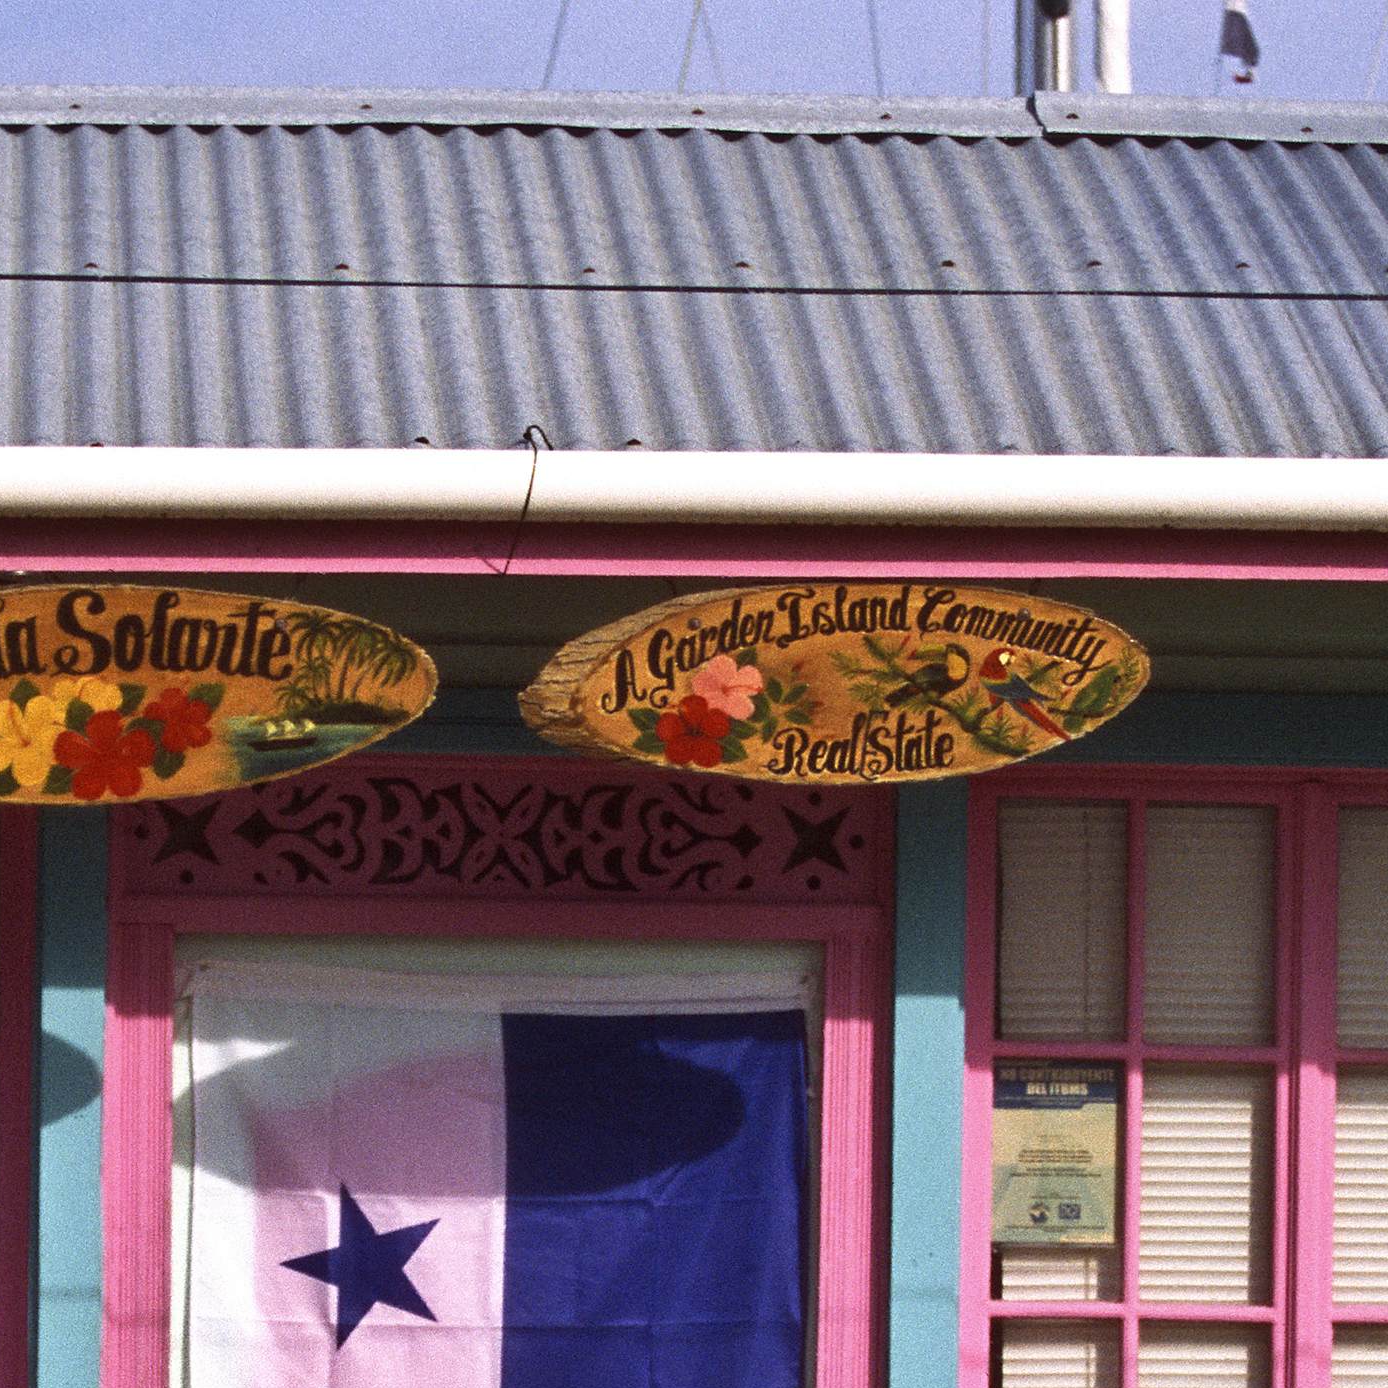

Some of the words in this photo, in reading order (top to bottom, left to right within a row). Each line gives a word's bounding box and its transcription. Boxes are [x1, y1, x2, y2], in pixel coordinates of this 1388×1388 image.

[48, 589, 294, 681] Solante
[601, 649, 647, 714] A
[647, 599, 777, 708] Garden
[776, 585, 910, 648] Island
[917, 587, 1112, 686] Community
[763, 711, 868, 777] Real
